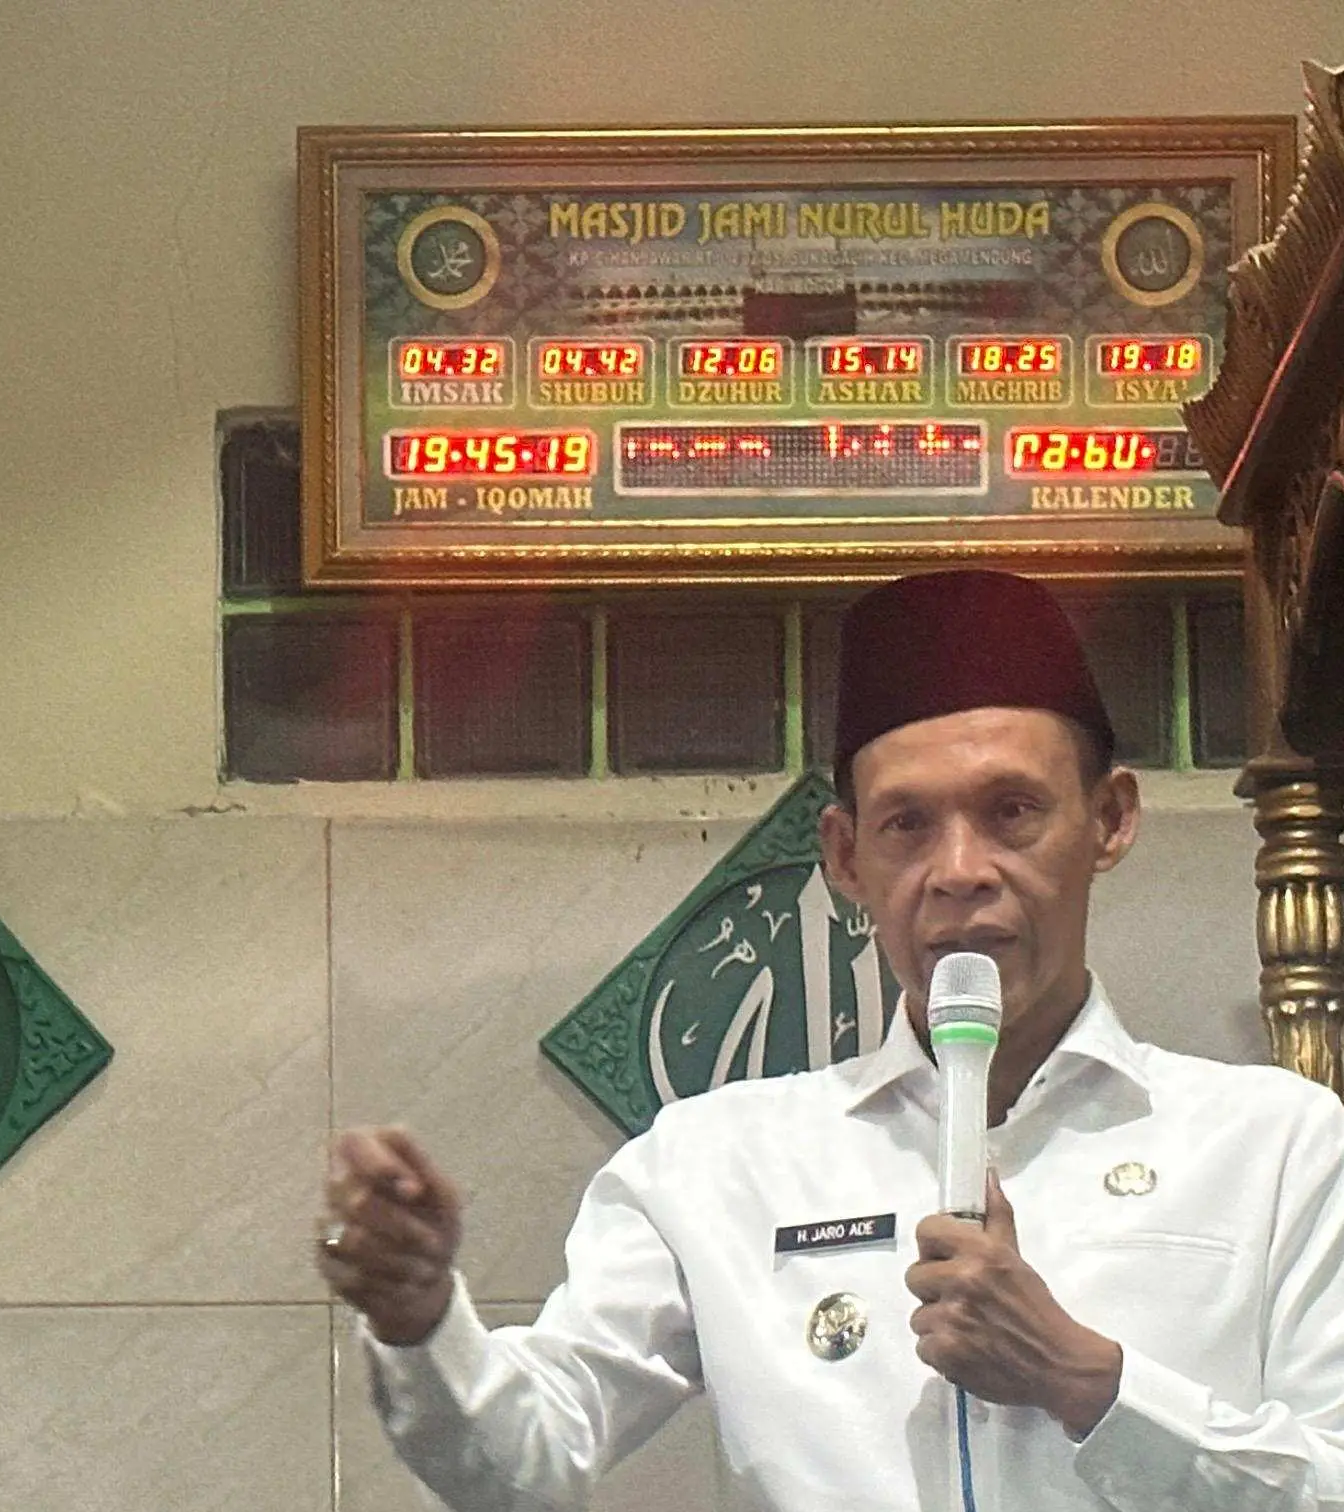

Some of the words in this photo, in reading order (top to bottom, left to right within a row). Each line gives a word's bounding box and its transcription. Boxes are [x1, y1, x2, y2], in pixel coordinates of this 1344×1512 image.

[549, 201, 686, 246] MASJID
[697, 202, 787, 246] JAMI
[797, 201, 930, 243] NURUL
[939, 200, 1050, 241] HUDA
[401, 381, 503, 404] IMSAK
[539, 381, 644, 404] SHUBUH
[679, 380, 782, 403] DZUHUR
[819, 380, 922, 402] ASHAR
[957, 380, 1062, 402] MAGHRIB
[1115, 379, 1189, 402] ISYA'
[393, 487, 448, 515] JAM
[476, 486, 593, 513] IQOMAH
[1032, 485, 1194, 511] KALENDER
[811, 1223, 845, 1242] JARO
[849, 1220, 875, 1237] ADE
